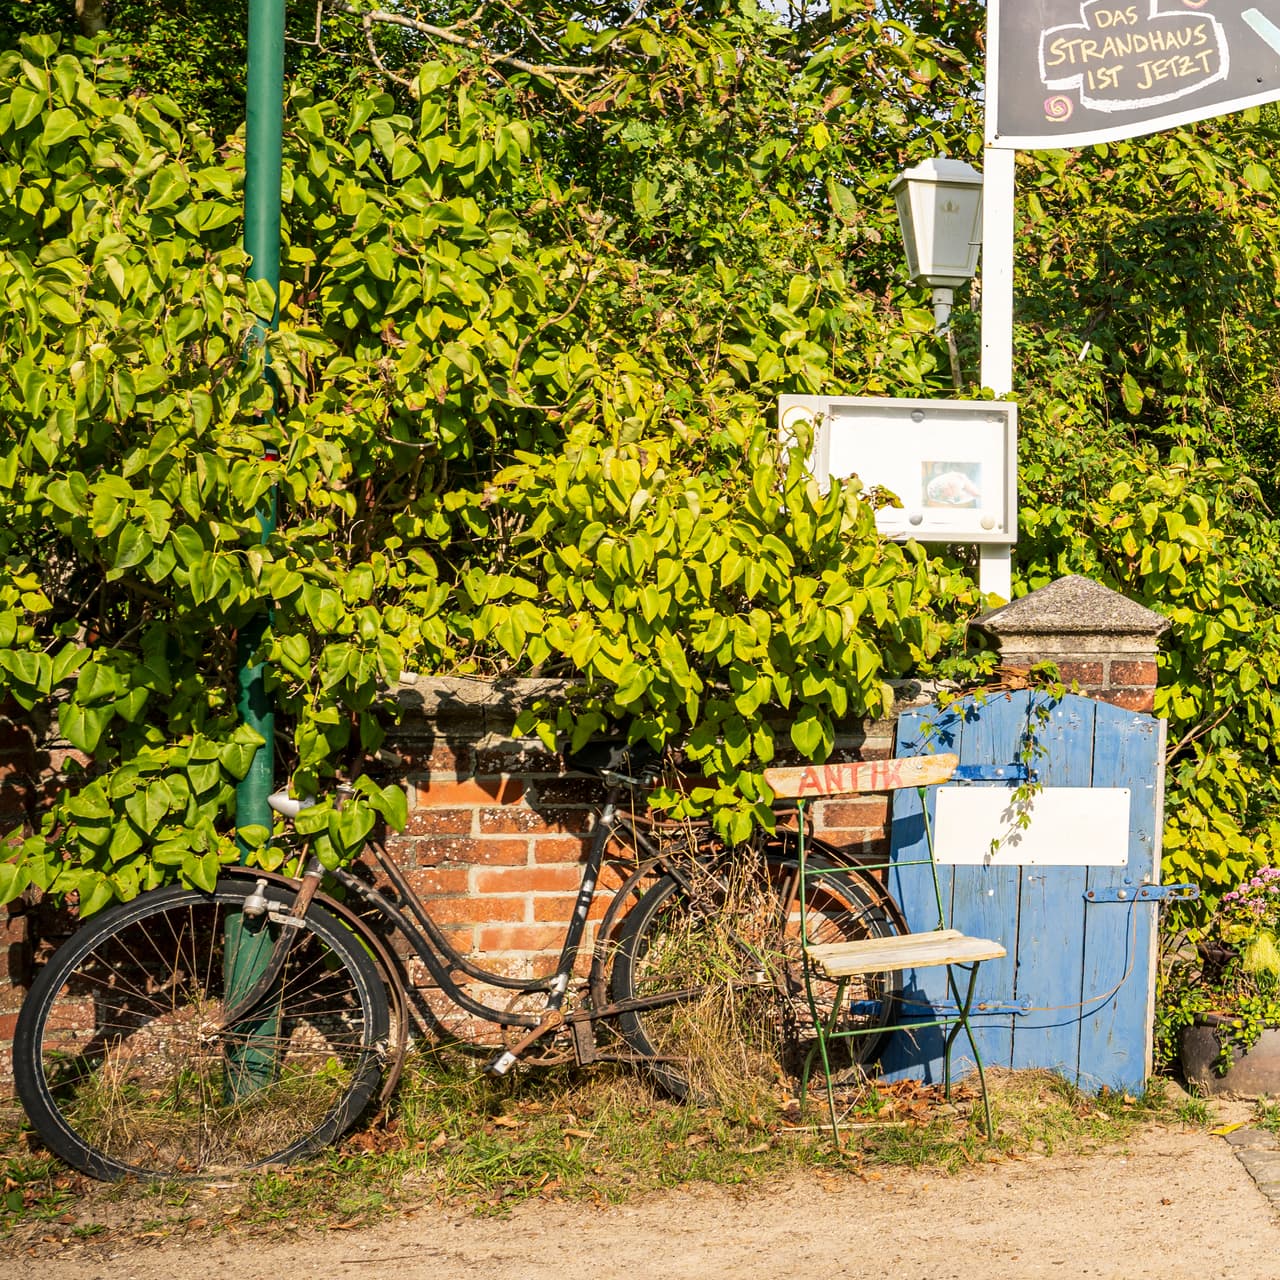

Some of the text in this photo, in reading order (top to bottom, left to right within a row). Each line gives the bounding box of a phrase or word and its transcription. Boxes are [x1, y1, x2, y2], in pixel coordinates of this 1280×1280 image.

[1095, 5, 1138, 29] DAS
[1046, 23, 1208, 66] STRANDHAUS
[1087, 49, 1214, 90] IST JETZT
